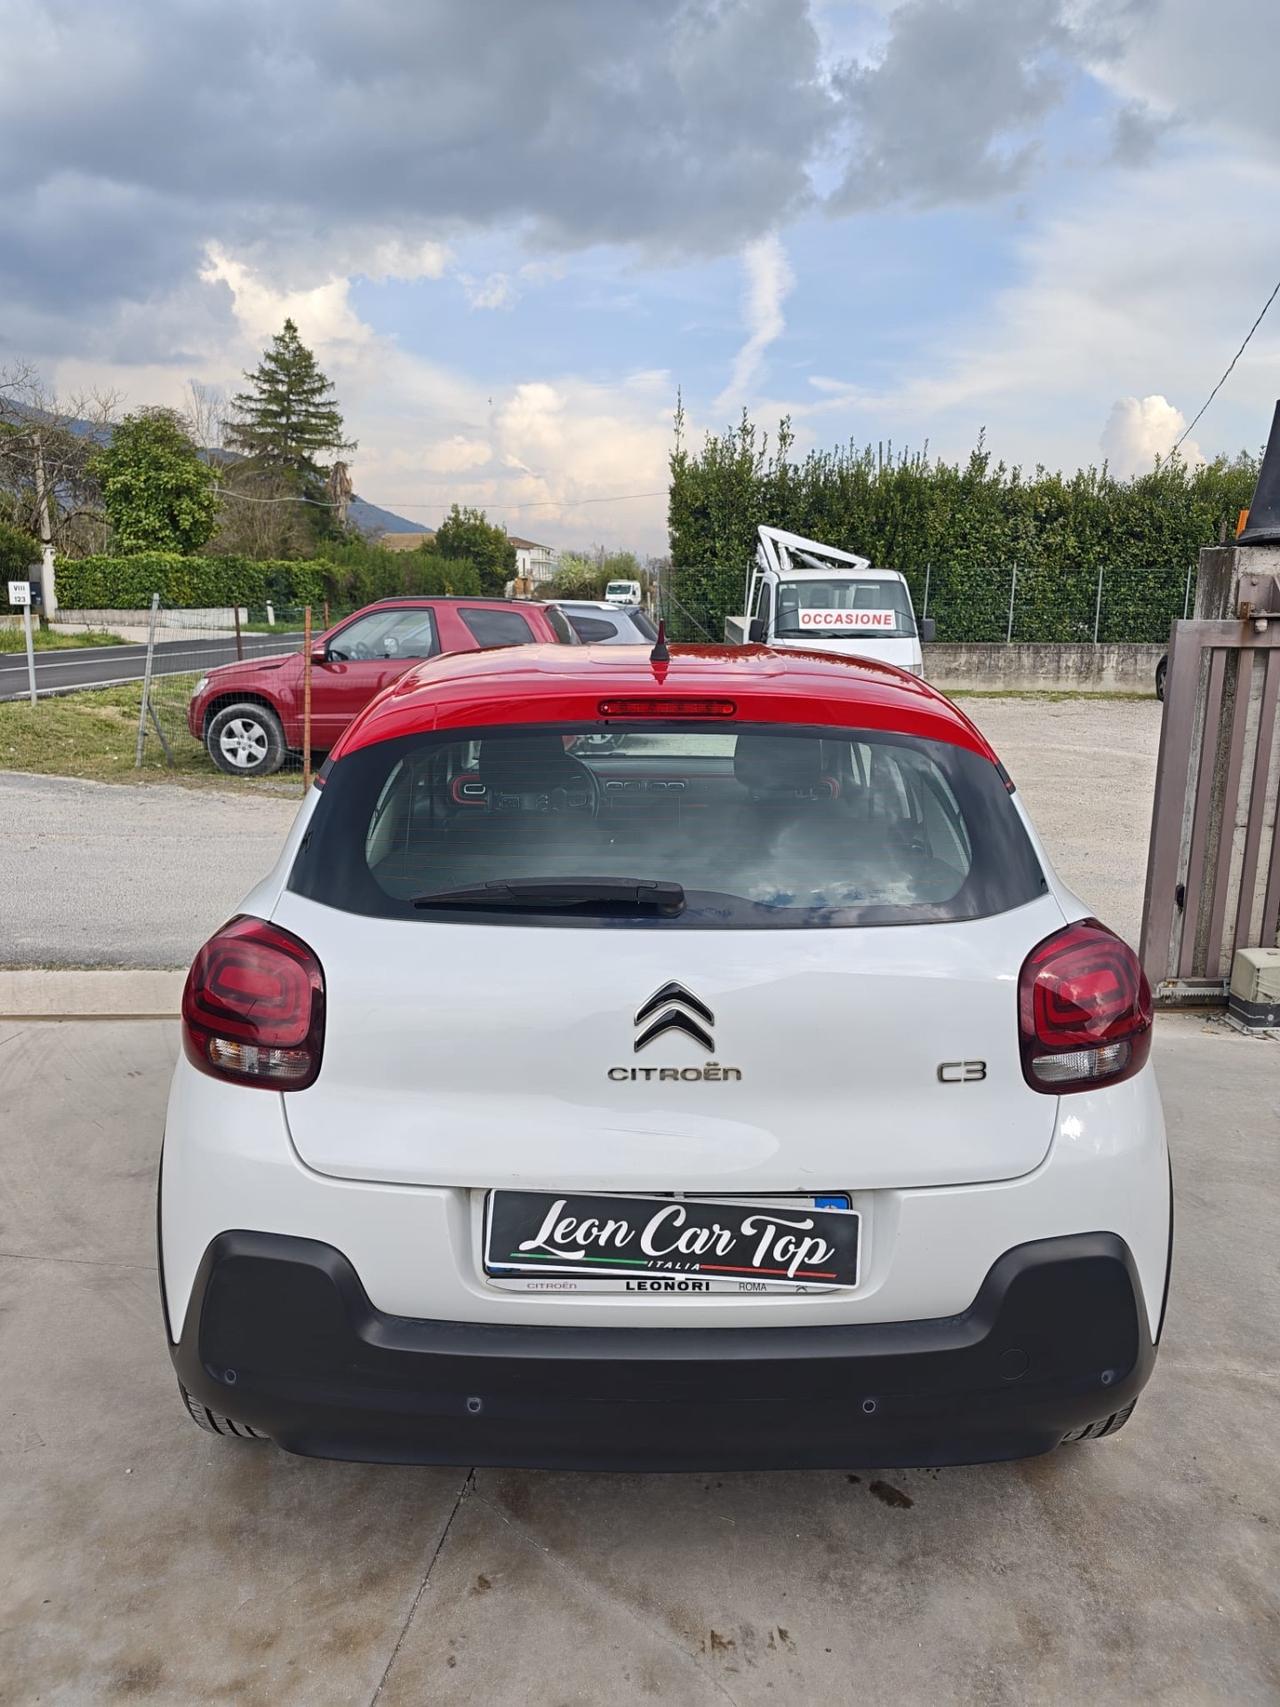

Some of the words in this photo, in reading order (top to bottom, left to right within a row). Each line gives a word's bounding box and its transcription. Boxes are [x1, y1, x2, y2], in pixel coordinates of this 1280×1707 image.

[801, 613, 893, 626] OCCASIONE
[937, 1061, 987, 1082] C3
[518, 1199, 635, 1260] Leon
[640, 1205, 737, 1256] Car
[740, 1215, 835, 1278] Top
[647, 1260, 700, 1271] ITALIA
[625, 1281, 710, 1291] LEONORI
[738, 1282, 767, 1292] ROMA
